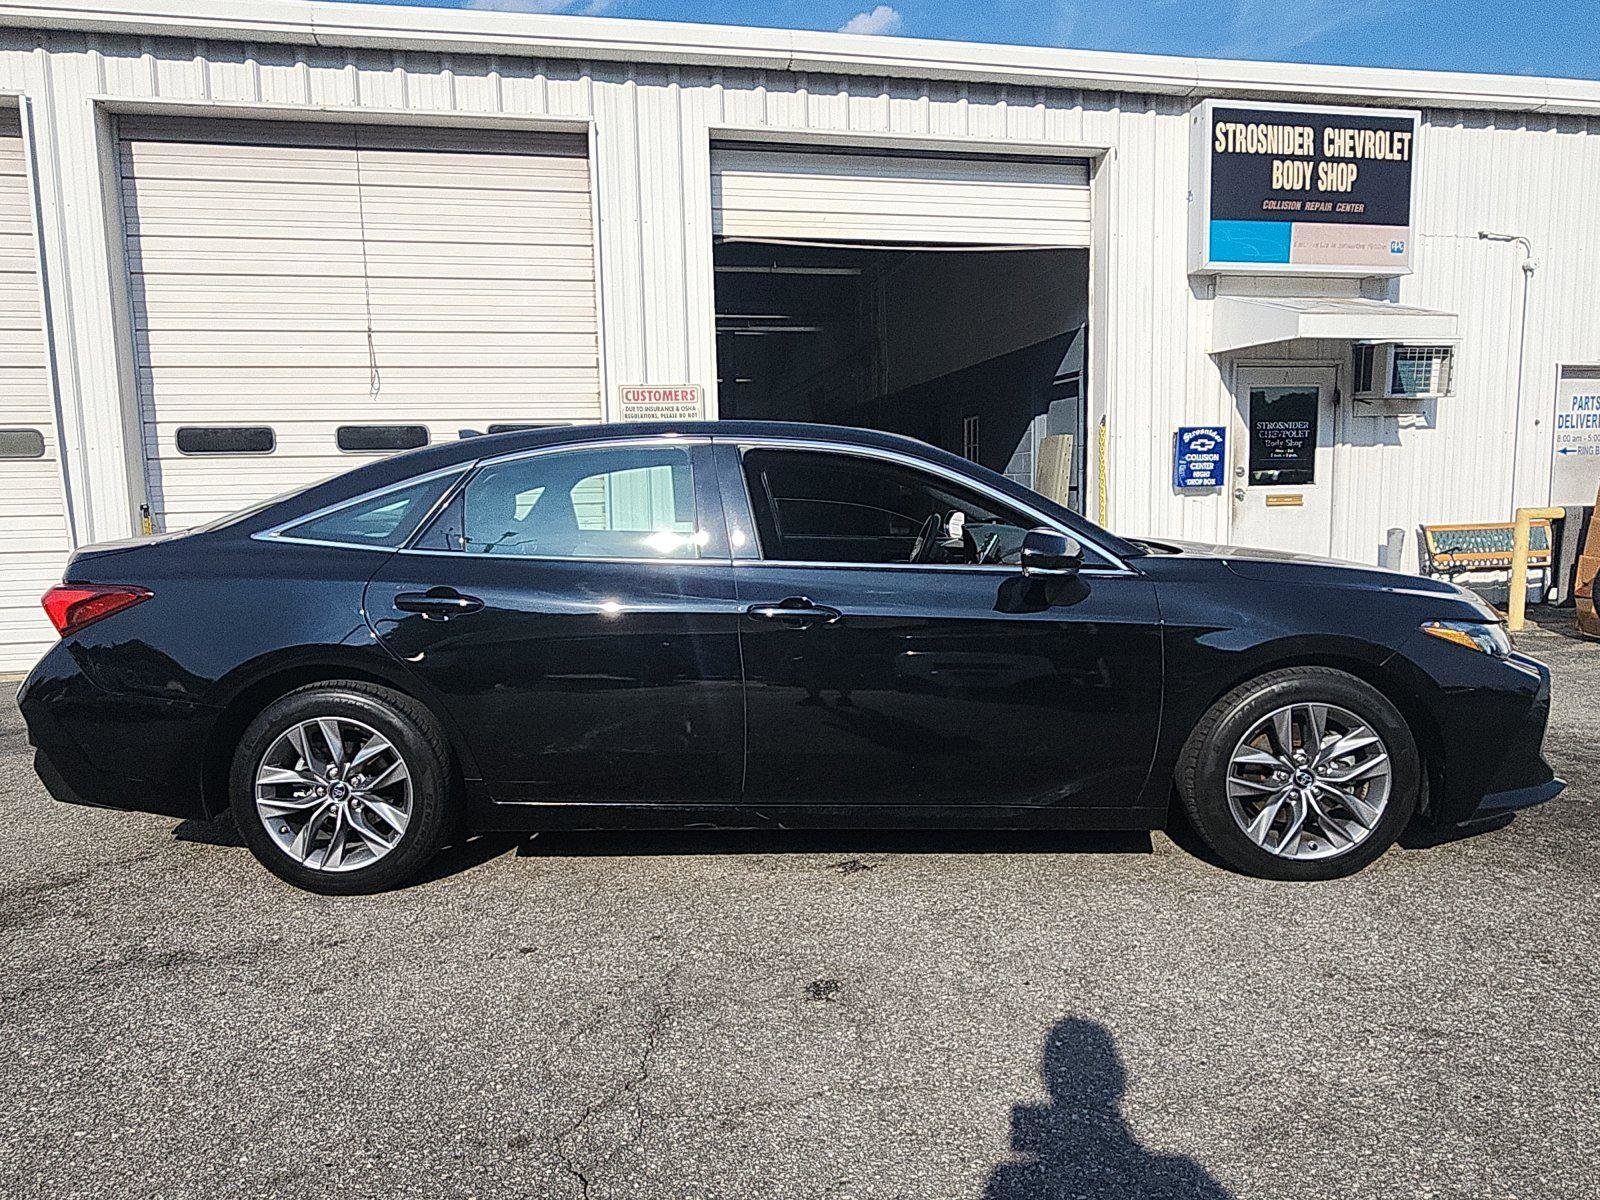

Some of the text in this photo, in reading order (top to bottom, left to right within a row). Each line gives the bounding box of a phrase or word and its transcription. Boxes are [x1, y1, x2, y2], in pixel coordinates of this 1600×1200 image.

[1214, 121, 1412, 161] STROSNIDER CHEVROLET
[1272, 159, 1358, 192] BODY SHOP
[1262, 200, 1365, 213] COLLISION REPAIR CENTER
[624, 389, 696, 402] CUSTOMERS
[1571, 395, 1600, 411] PARTS
[1256, 421, 1310, 430] STROSNIDER
[1258, 430, 1311, 439] CHEVROLET
[1578, 445, 1594, 455] RING
[1185, 453, 1220, 461] COLLISION
[1189, 462, 1215, 470] CENTER
